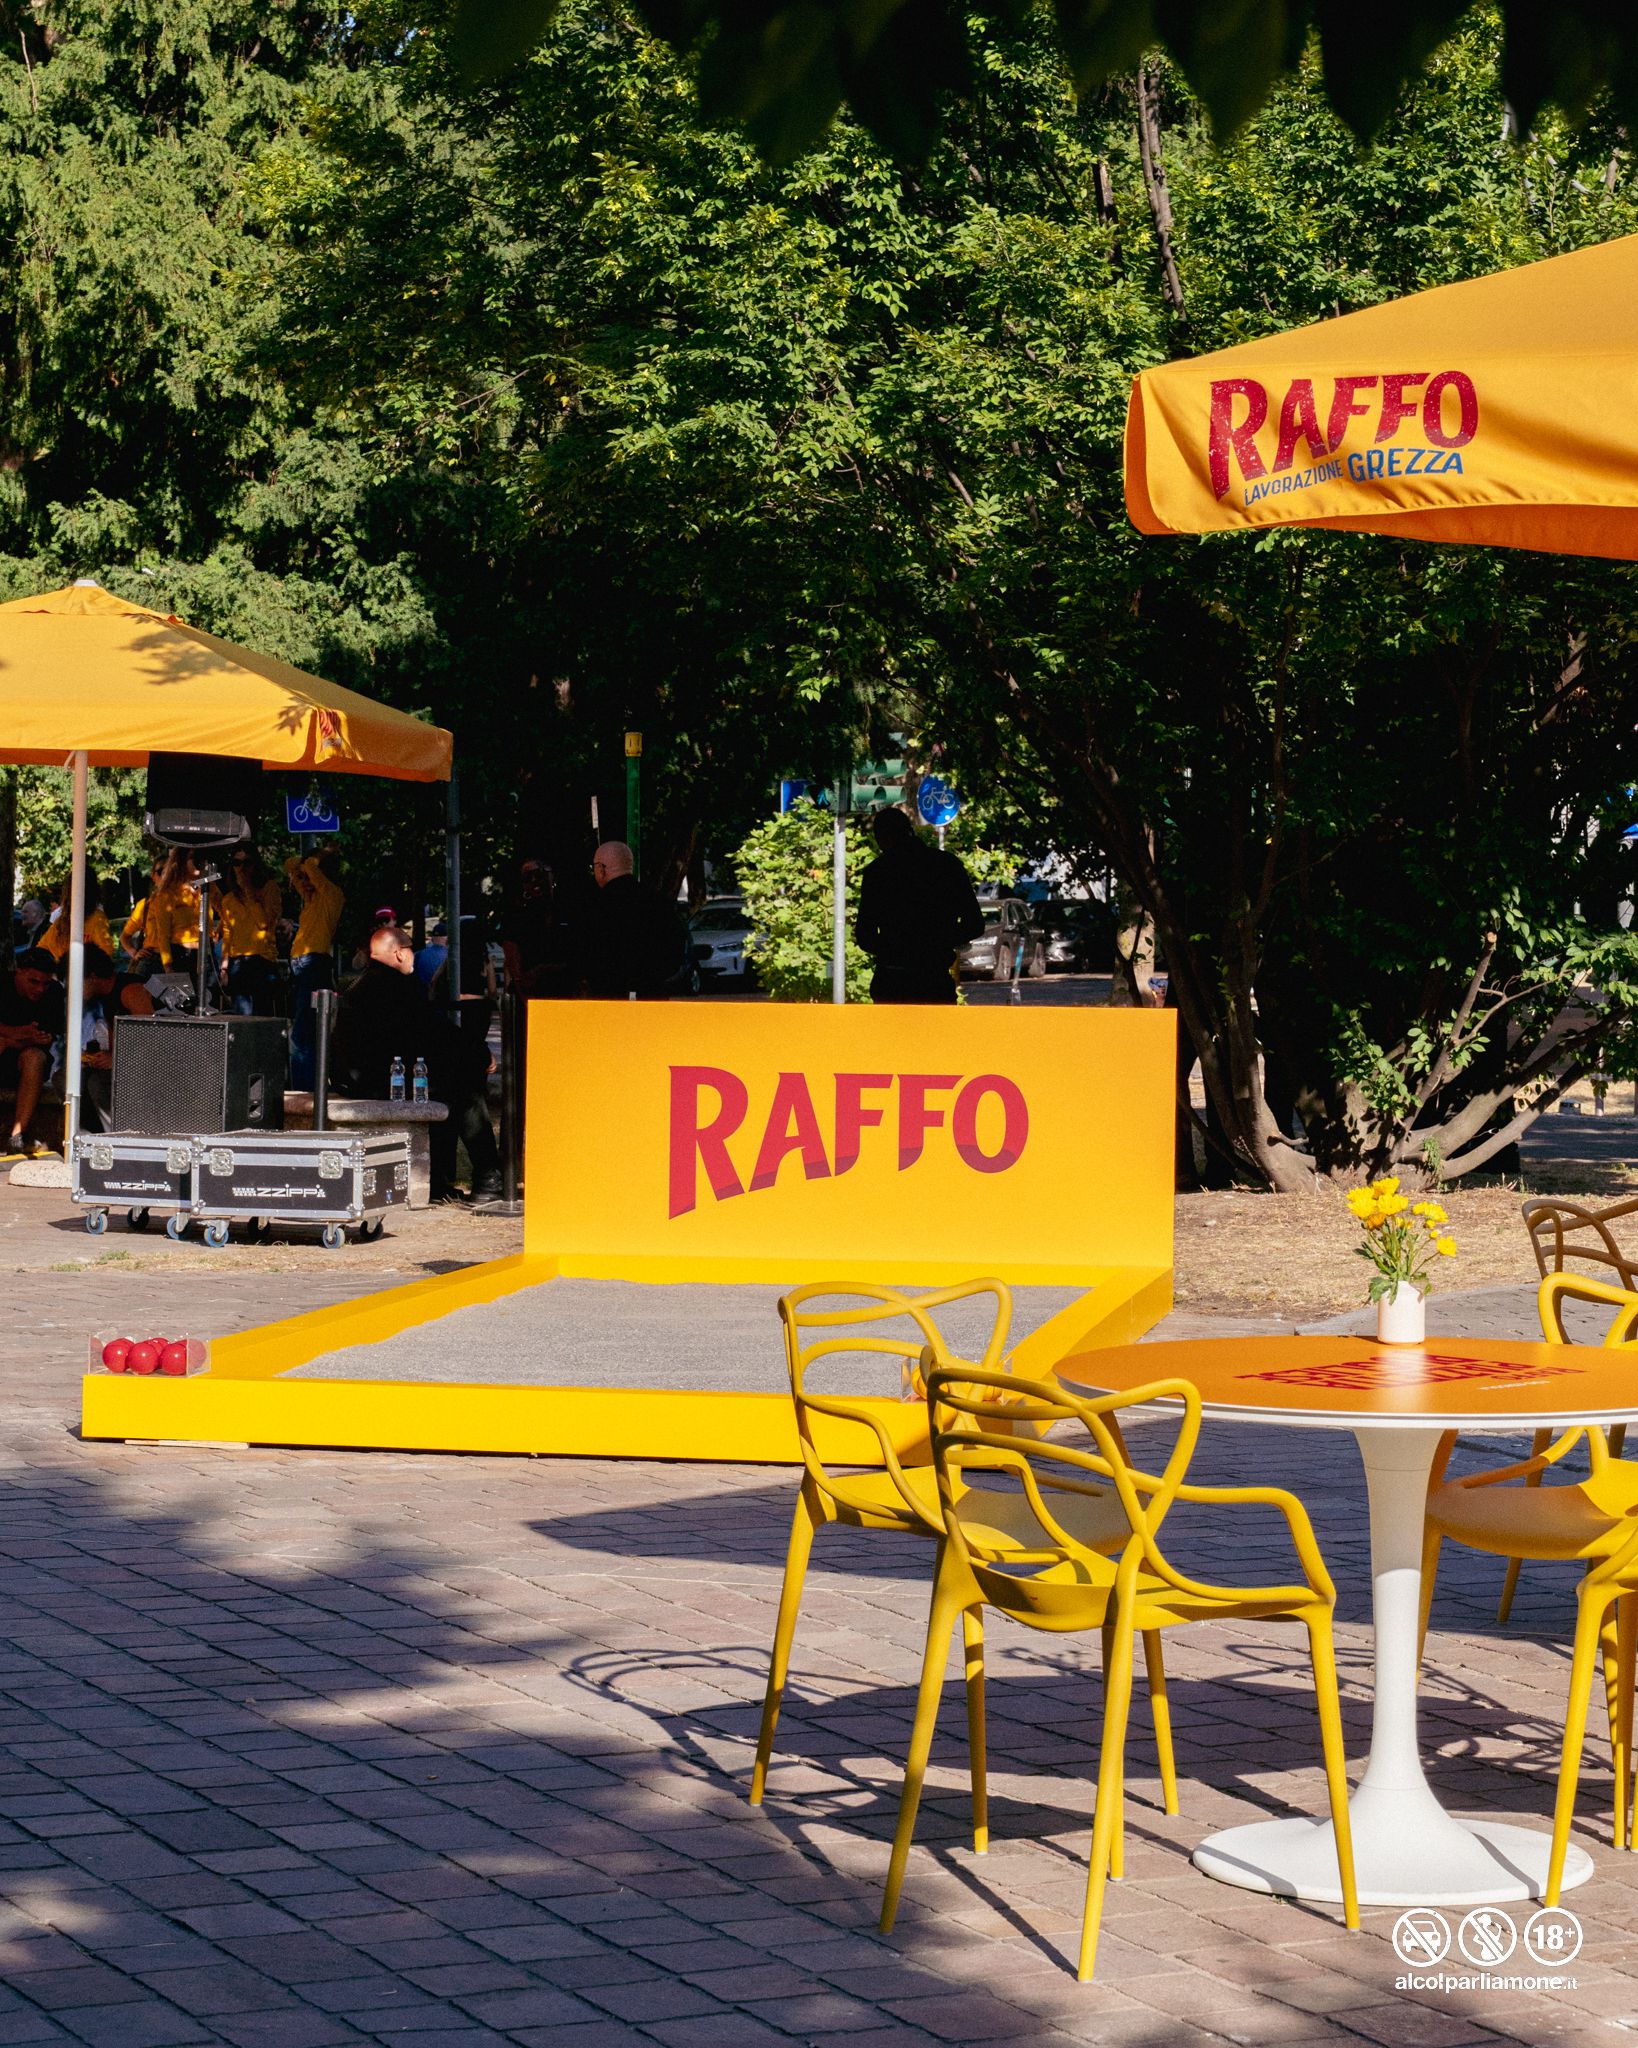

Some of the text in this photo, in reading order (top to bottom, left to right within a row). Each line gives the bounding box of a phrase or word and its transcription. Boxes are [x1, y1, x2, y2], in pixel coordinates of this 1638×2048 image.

[1209, 370, 1479, 500] RAFFO
[1244, 447, 1464, 507] LAVORAZIONE GREZZA
[669, 1065, 1029, 1220] RAFFO
